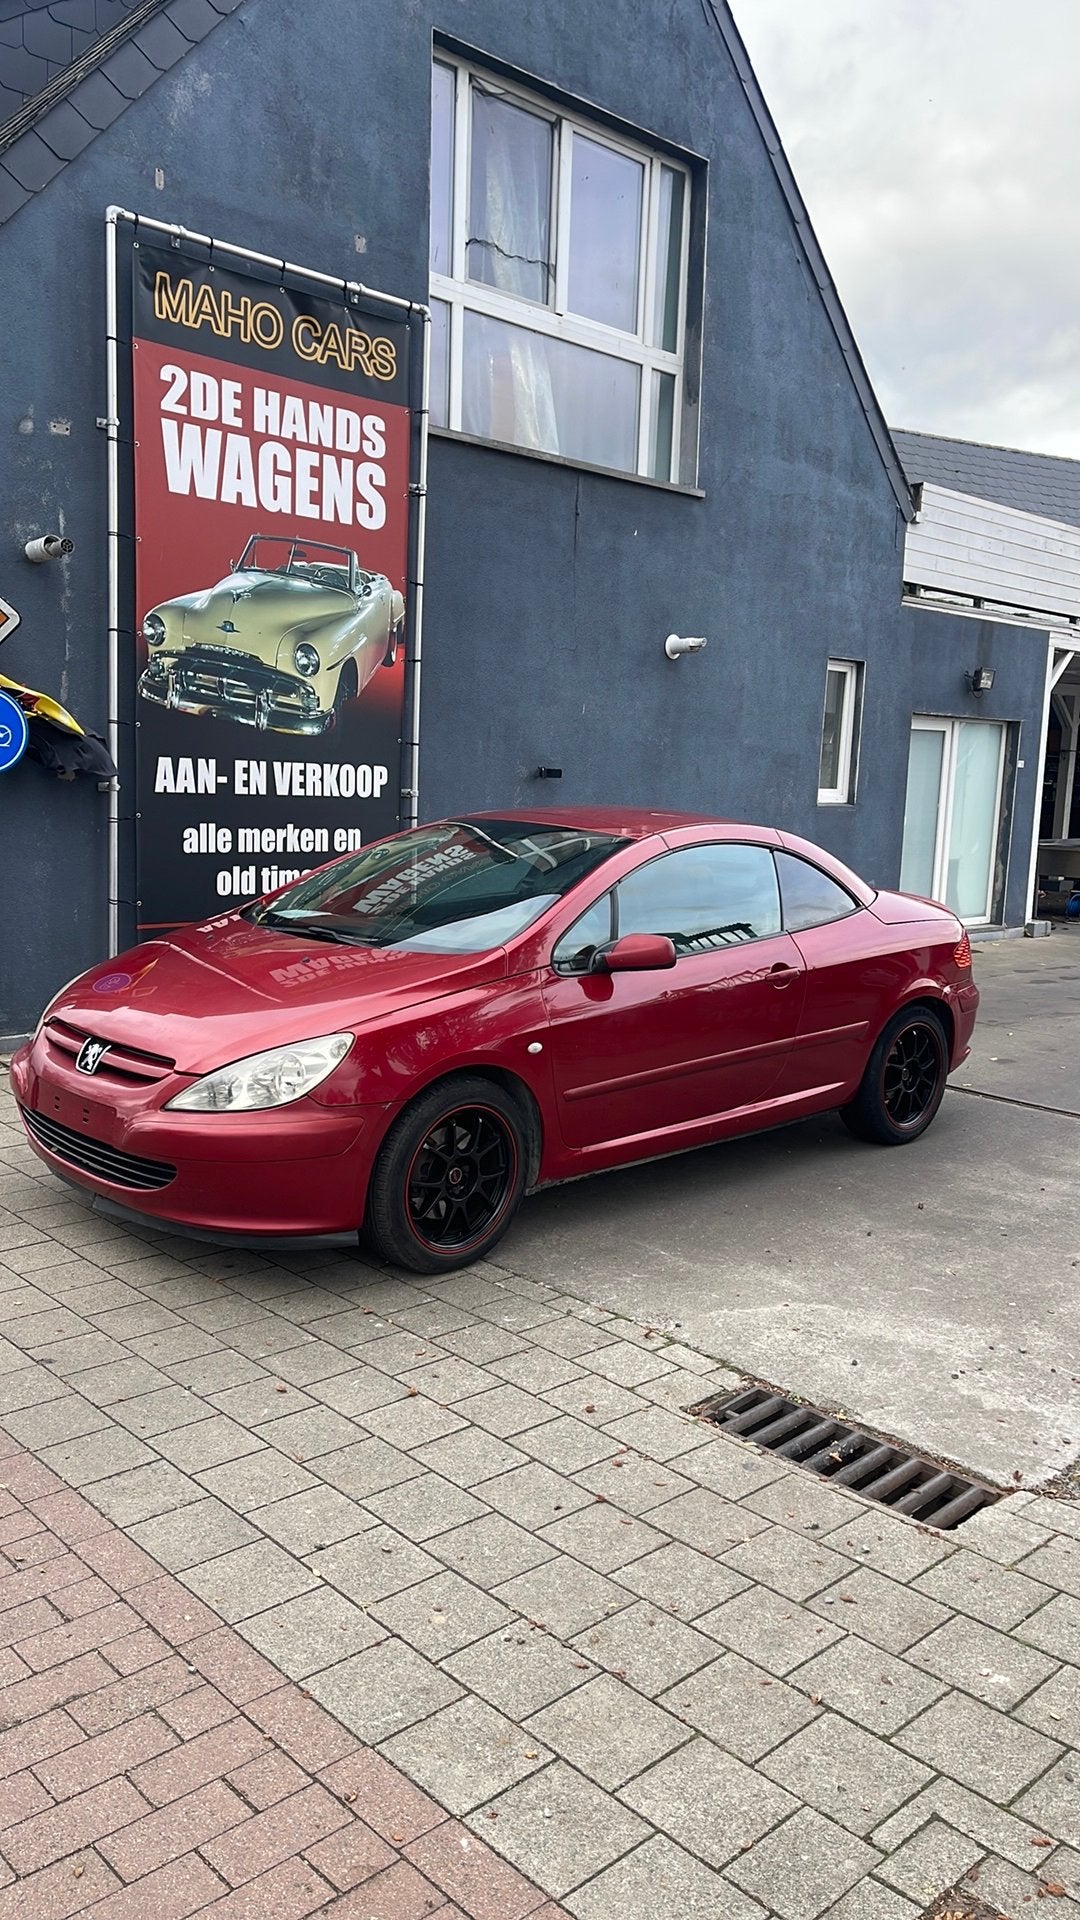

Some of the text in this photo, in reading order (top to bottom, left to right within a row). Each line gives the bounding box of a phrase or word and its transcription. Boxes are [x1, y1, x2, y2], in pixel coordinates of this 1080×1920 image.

[155, 271, 397, 381] MAHO CARS
[160, 364, 386, 459] 2DE HANDS
[161, 417, 387, 530] WAGENS
[154, 756, 389, 798] AAN- EN VERKOOP
[182, 823, 361, 853] alle merken en
[216, 865, 313, 896] old tim
